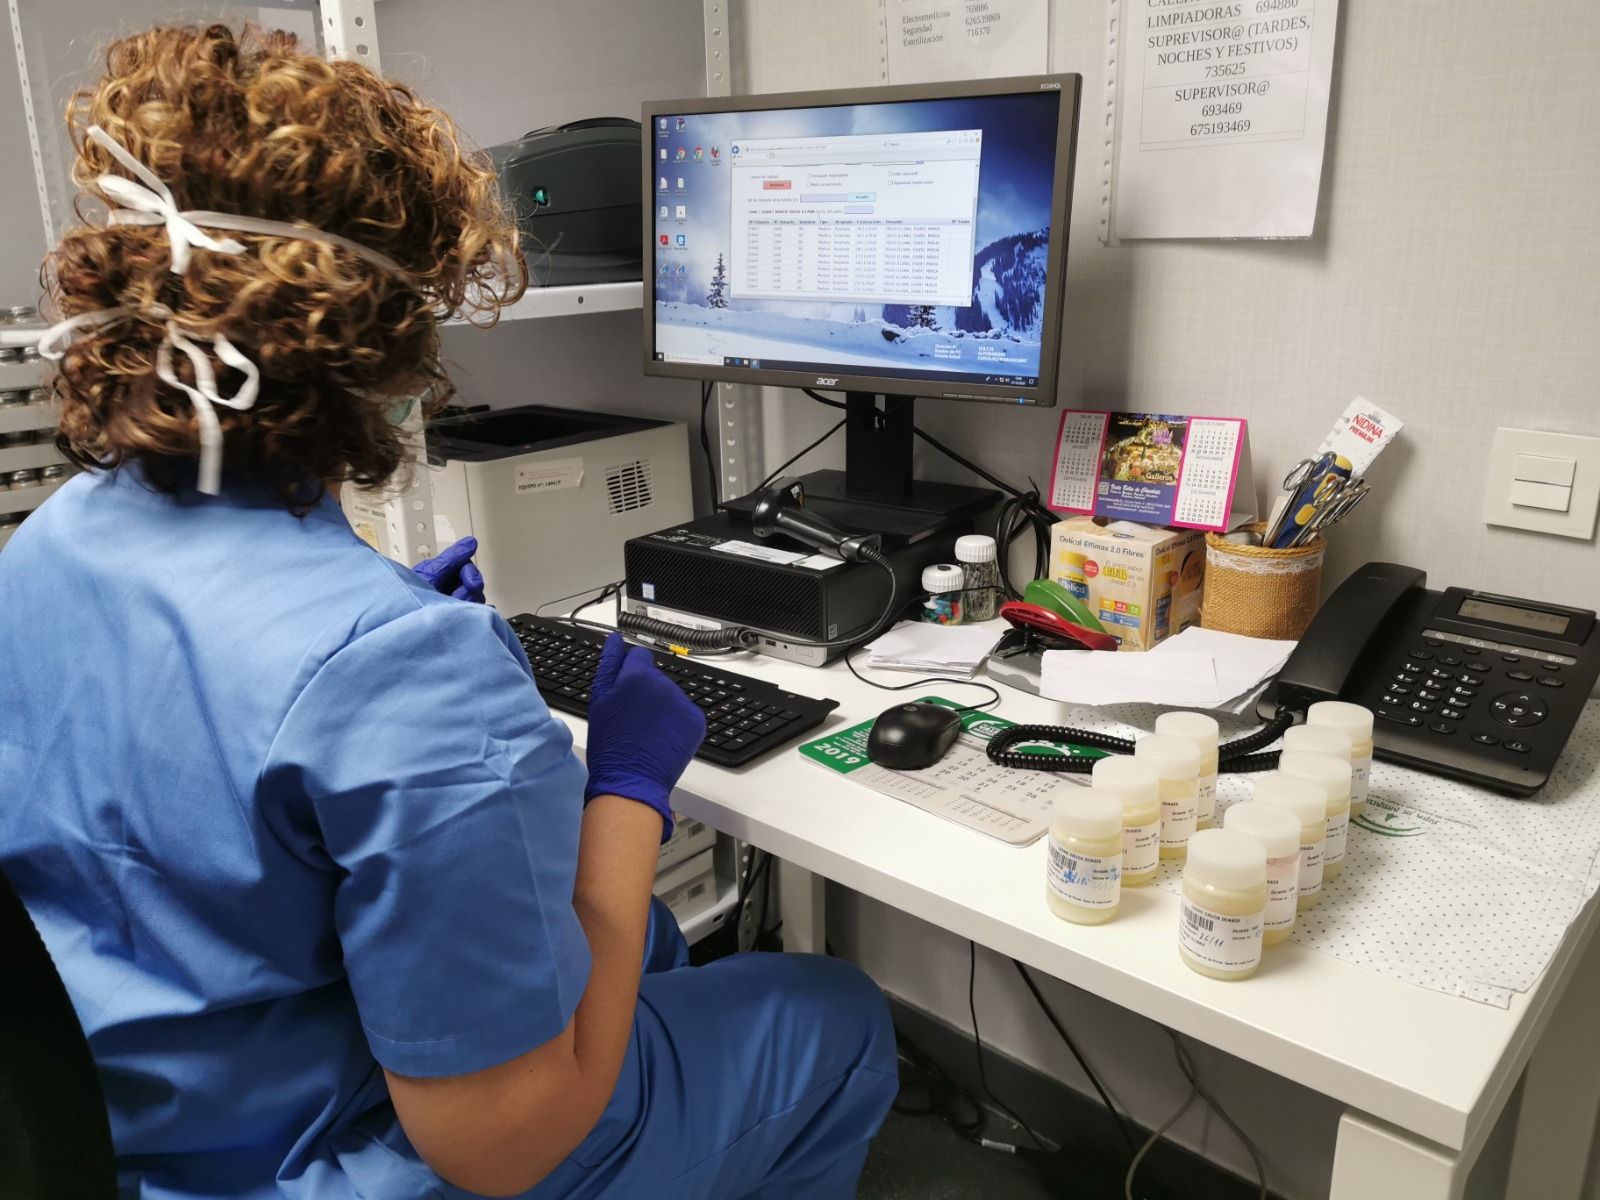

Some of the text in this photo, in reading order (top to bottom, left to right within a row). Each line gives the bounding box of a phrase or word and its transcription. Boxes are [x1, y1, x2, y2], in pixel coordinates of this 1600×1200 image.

[1148, 4, 1241, 28] LIMPIADORAS
[1256, 0, 1299, 14] 694880
[903, 24, 933, 35] Seguridad
[1148, 16, 1310, 48] SUPREVISOR@ (TARDES,
[1157, 37, 1298, 66] NOCHES Y FESTIVOS)
[1205, 62, 1246, 78] 735625
[1175, 80, 1270, 102] SUPERVISOR@
[1201, 102, 1242, 117] 693469
[1190, 120, 1251, 136] 675193469
[816, 376, 840, 386] acer
[1348, 425, 1375, 444] PREMIUM
[1352, 414, 1384, 438] NIDINA
[1083, 540, 1109, 552] Effimax
[1110, 545, 1121, 554] 2.0
[1122, 548, 1144, 558] Fibres
[814, 742, 861, 764] 2019
